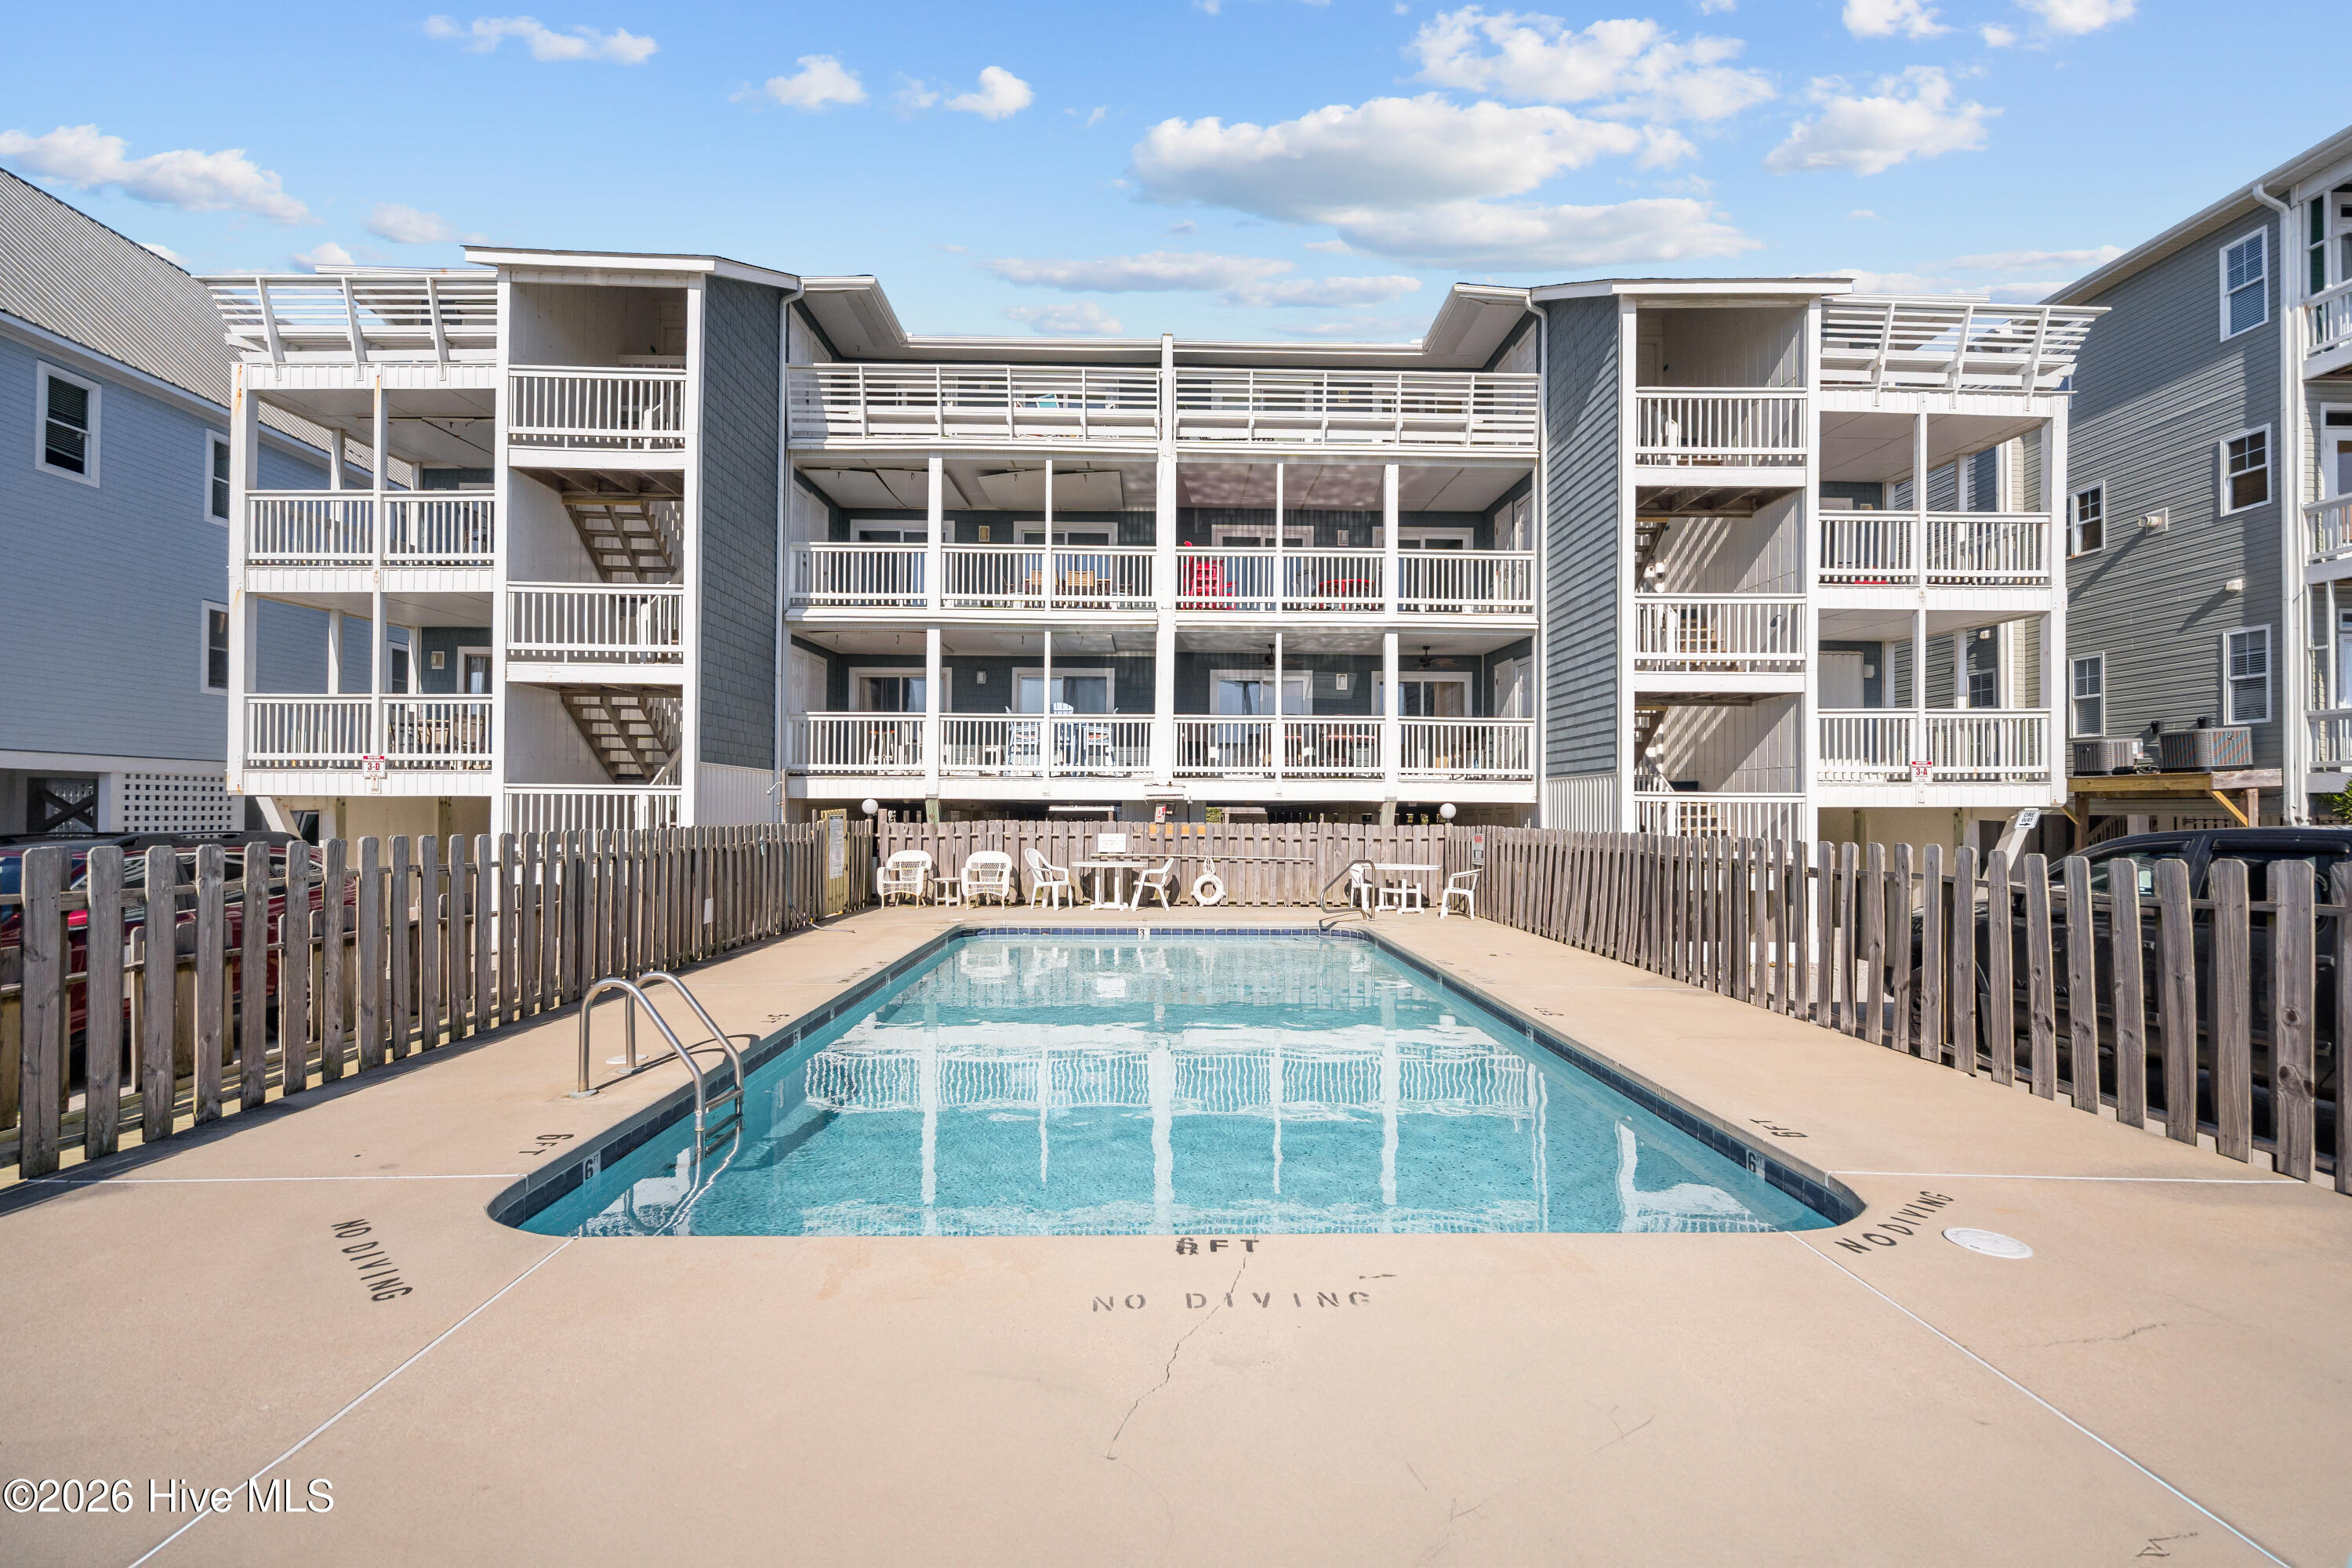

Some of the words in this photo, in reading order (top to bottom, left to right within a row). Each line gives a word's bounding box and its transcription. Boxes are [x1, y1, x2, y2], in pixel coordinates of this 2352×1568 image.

[1749, 1119, 1808, 1138] 6FT
[518, 1134, 574, 1156] 6FT
[331, 1218, 372, 1238] NO
[1834, 1232, 1897, 1254] NO
[1877, 1190, 1955, 1236] DIVING
[341, 1241, 413, 1301] DIVING
[1092, 1294, 1146, 1312] NO
[1185, 1292, 1370, 1309] DIVING
